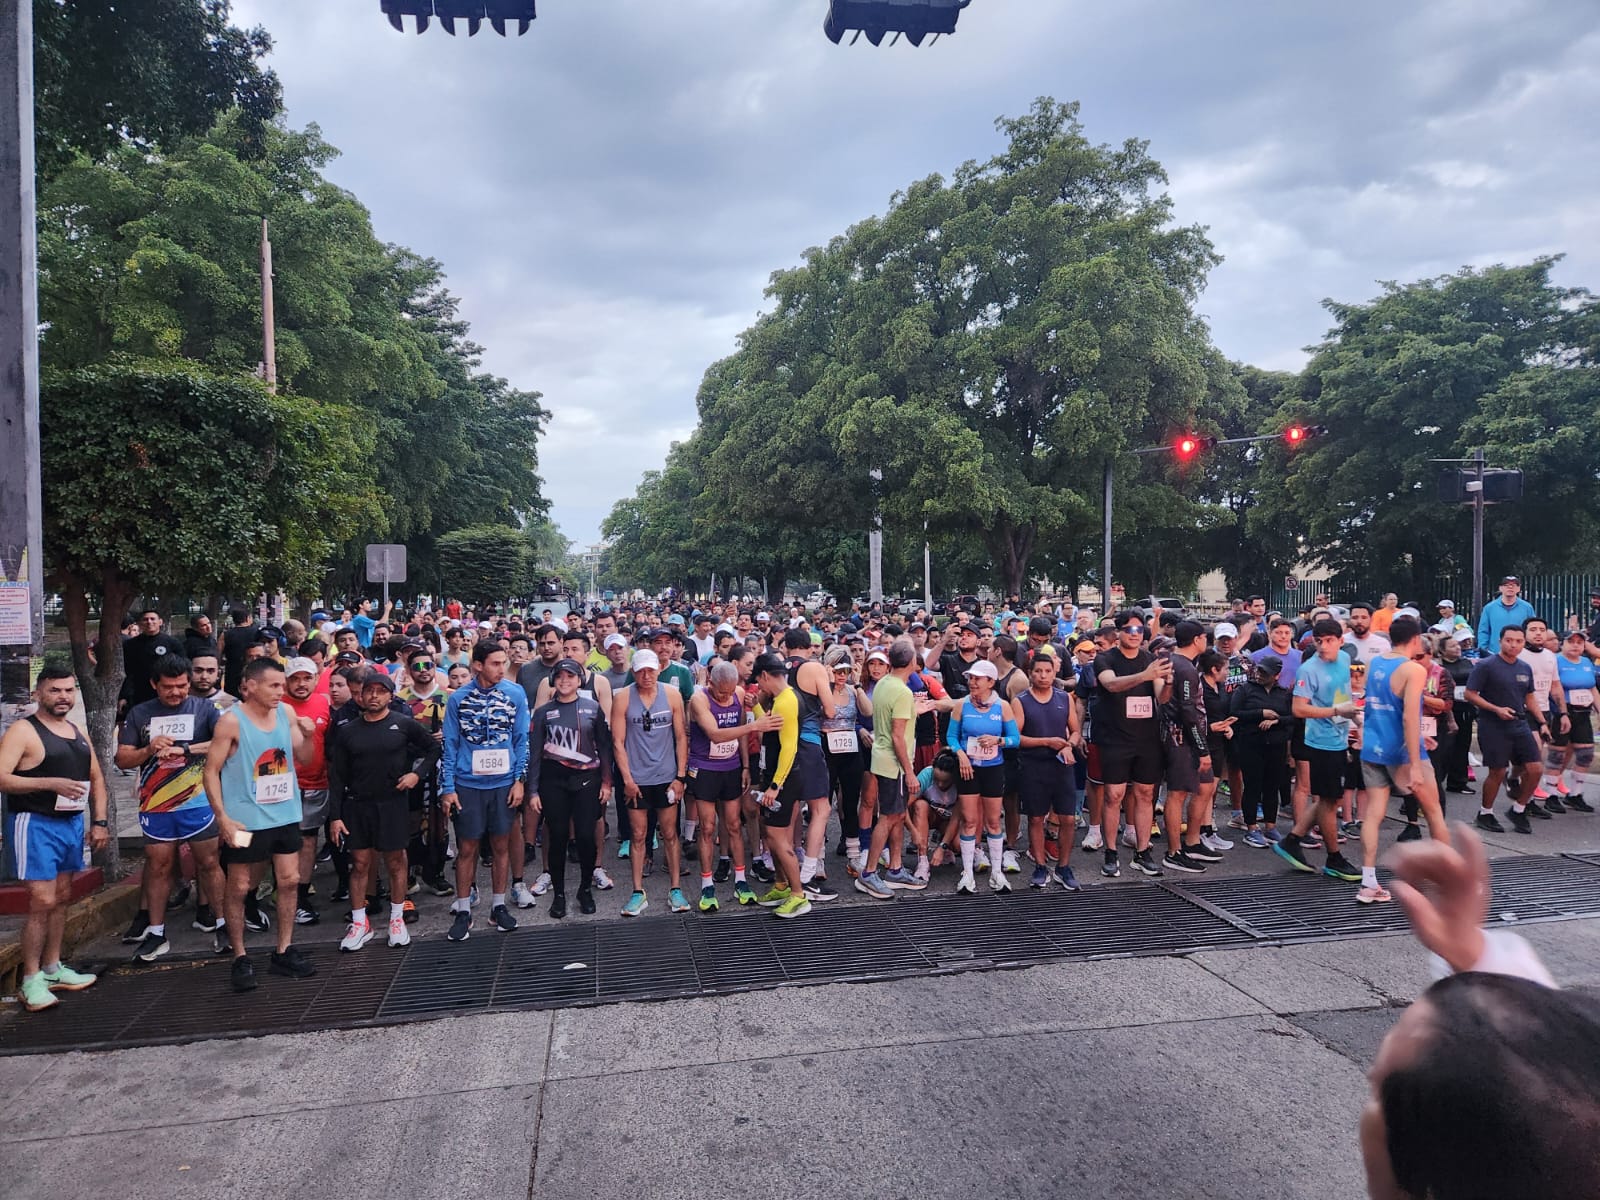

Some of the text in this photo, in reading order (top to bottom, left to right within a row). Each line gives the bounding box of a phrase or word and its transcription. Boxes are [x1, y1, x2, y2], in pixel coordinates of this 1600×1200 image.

[717, 711, 739, 720] TEAM
[158, 723, 186, 735] 1723
[834, 737, 853, 748] 1729
[479, 757, 503, 769] 1584
